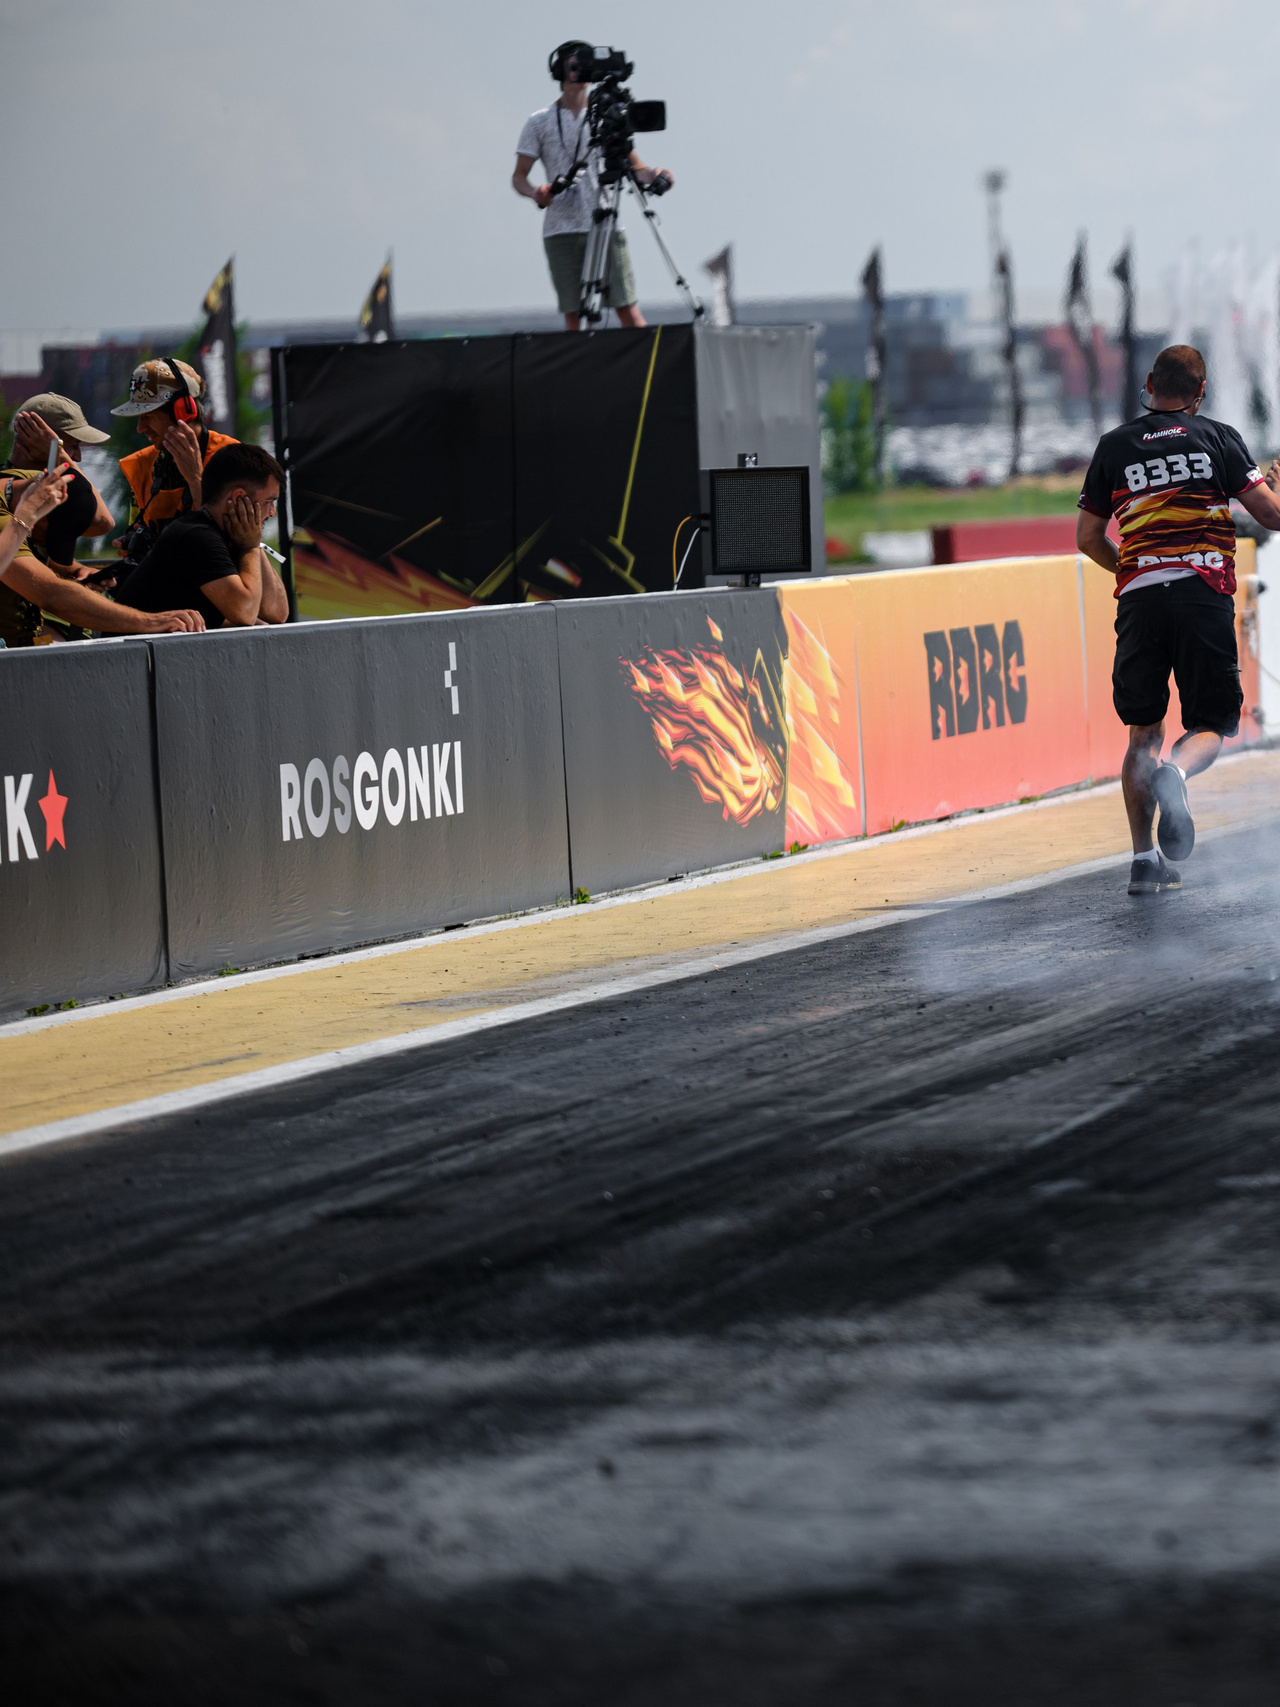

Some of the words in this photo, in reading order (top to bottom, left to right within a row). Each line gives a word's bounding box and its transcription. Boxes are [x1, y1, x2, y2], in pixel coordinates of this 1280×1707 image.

[1124, 453, 1213, 492] 8333
[923, 619, 1028, 741] RDRC
[279, 740, 464, 841] ROSGONKI
